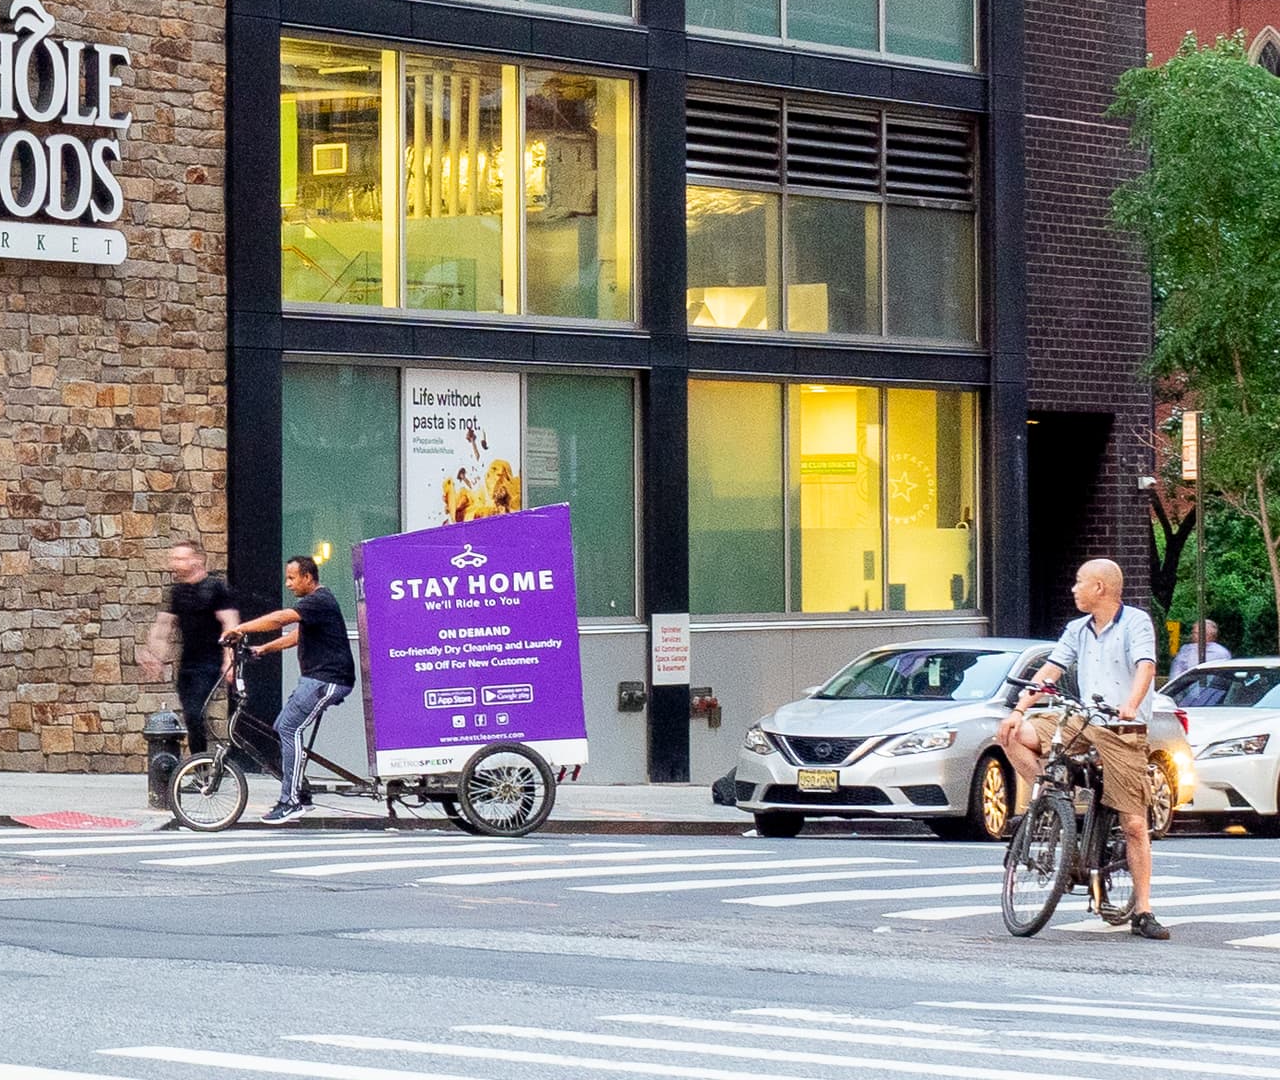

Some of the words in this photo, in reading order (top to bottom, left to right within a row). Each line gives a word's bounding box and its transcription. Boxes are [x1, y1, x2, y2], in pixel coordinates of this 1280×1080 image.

[412, 387, 434, 406] Life
[437, 388, 481, 407] without
[413, 413, 444, 433] pasta
[447, 412, 457, 430] is
[459, 415, 481, 431] not.
[390, 576, 459, 600] STAY
[468, 570, 554, 595] HOME
[425, 599, 452, 611] We'll
[456, 598, 480, 609] Ride
[484, 598, 496, 607] to
[500, 596, 520, 606] You
[438, 628, 457, 640] ON
[458, 626, 511, 639] DEMAND
[389, 645, 442, 658] Eco-friendly
[444, 645, 461, 655] Dry
[463, 641, 503, 654] Cleaning
[505, 640, 523, 651] and
[524, 638, 562, 650] Laundry
[434, 660, 450, 671] Off
[451, 659, 466, 669] For
[468, 659, 489, 669] New
[490, 656, 539, 667] Customers
[437, 696, 453, 706] App
[453, 695, 473, 704] Store
[496, 693, 518, 701] Google
[440, 732, 525, 743] www.nextcleaners.com
[390, 757, 454, 769] METROSPEEDY
